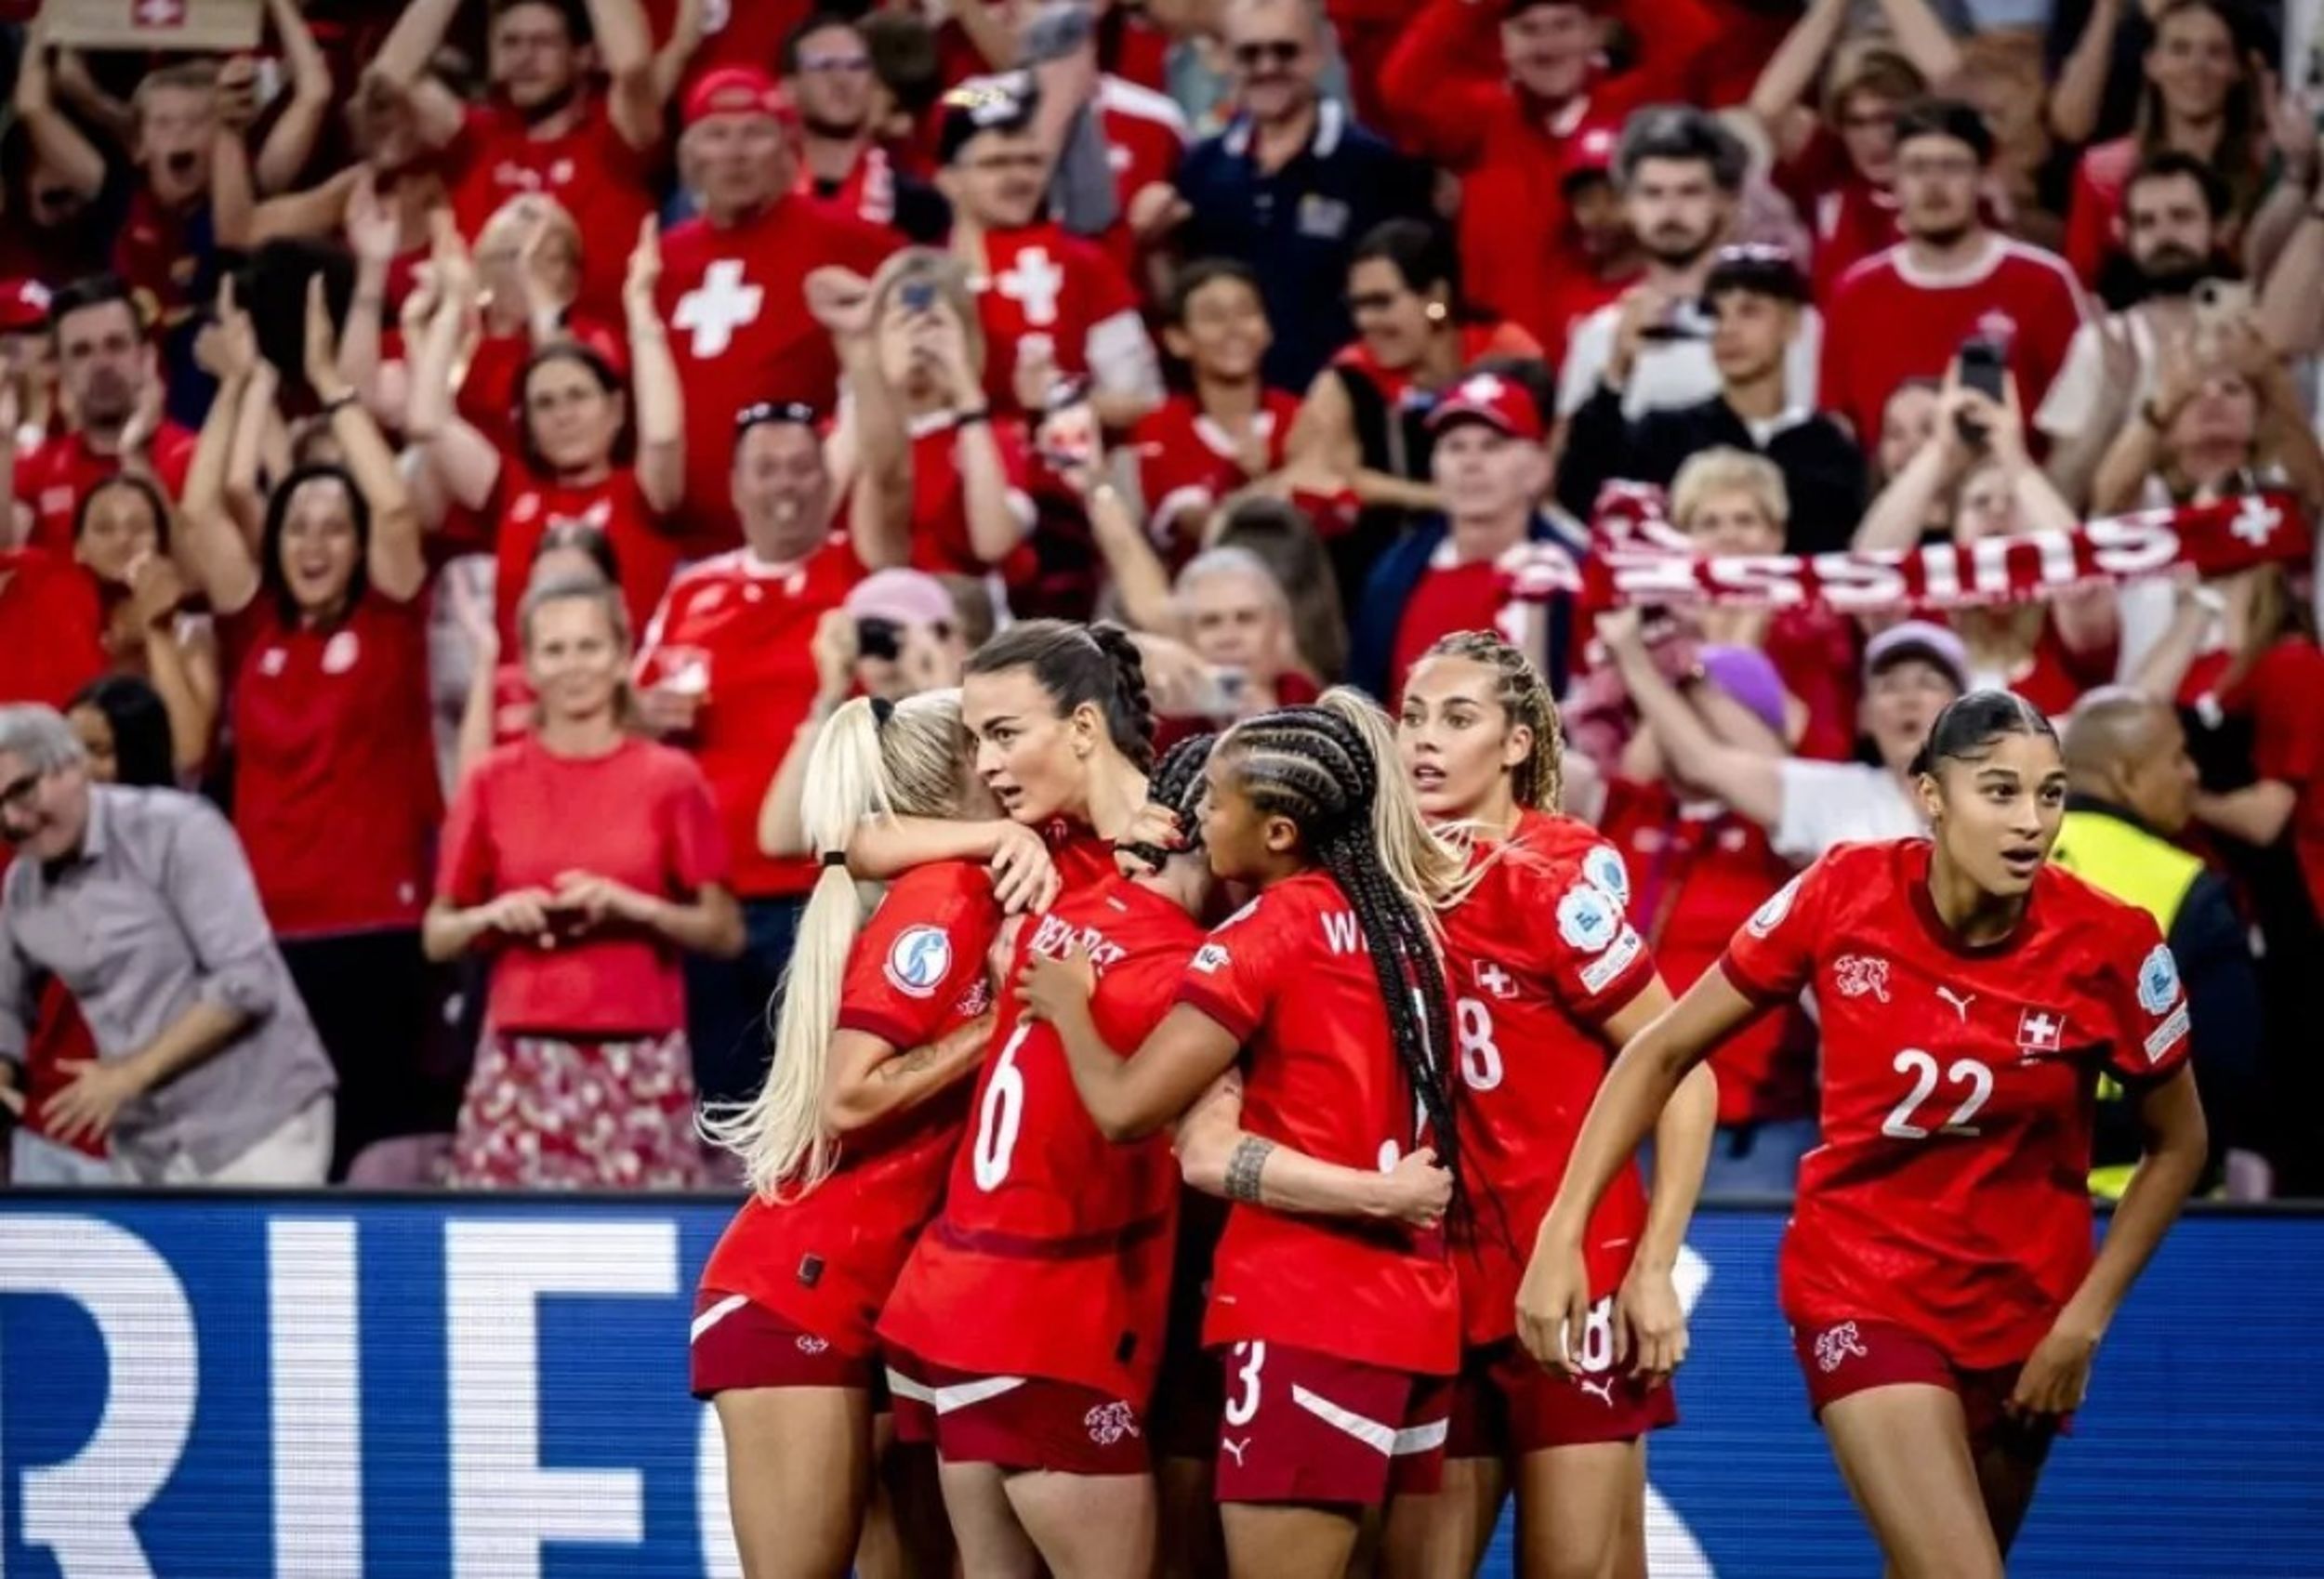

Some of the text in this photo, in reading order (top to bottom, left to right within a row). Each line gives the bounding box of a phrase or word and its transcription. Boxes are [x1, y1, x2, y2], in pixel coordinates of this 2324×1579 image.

[1611, 507, 2181, 608] SUISSE
[1456, 997, 1503, 1092] 8
[973, 1022, 1033, 1192] 6
[1882, 1047, 1994, 1139] 22
[1224, 1339, 1266, 1427] 3
